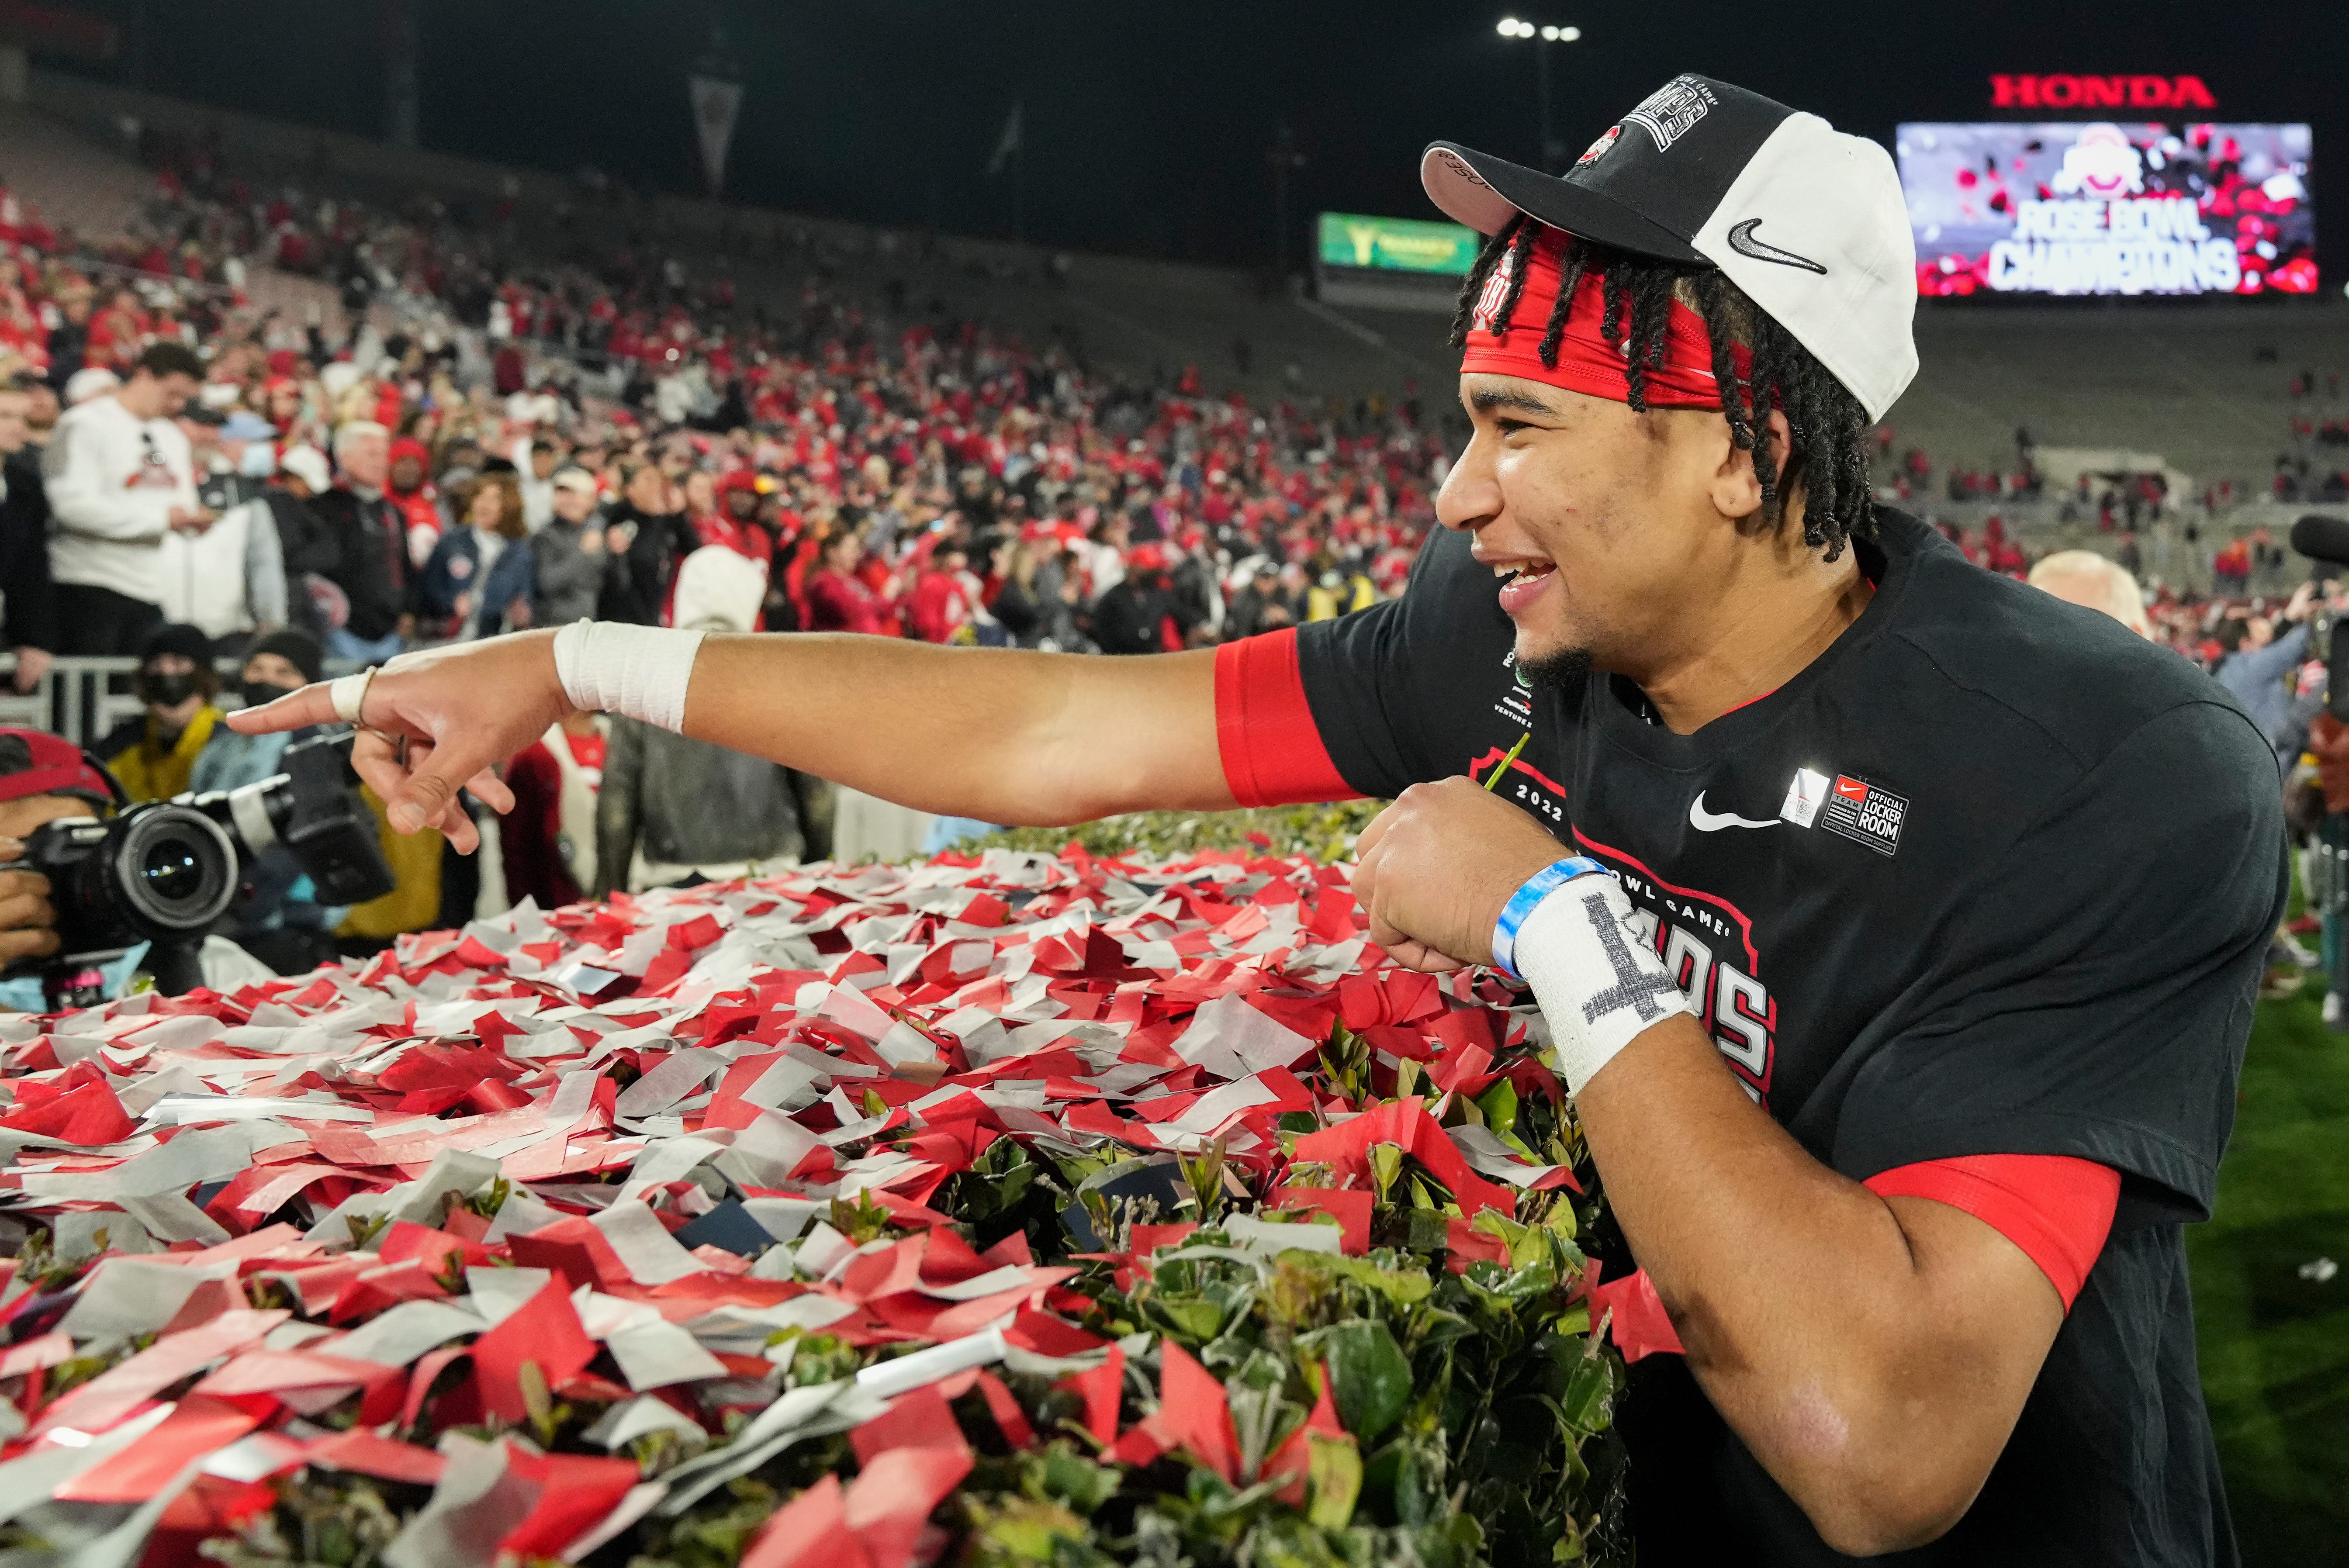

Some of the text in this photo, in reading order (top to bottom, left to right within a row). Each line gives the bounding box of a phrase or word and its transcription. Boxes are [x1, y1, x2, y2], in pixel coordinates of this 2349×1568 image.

[1990, 73, 2218, 108] HONDA
[2012, 198, 2211, 240] ROSE BOWL
[1989, 238, 2240, 294] CHAMPIONS
[1502, 647, 1515, 667] RO
[1494, 704, 1527, 725] VENTURE
[1516, 784, 1562, 822] 2022
[1835, 795, 1859, 808] TEAM
[1864, 799, 1902, 825] LOCKER
[1868, 791, 1904, 812] OFFICIAL
[1824, 821, 1892, 851] OFFICIAL LOCKER ROOM SUPPLIER
[1858, 812, 1899, 840] ROOM
[1609, 870, 1656, 899] OWL
